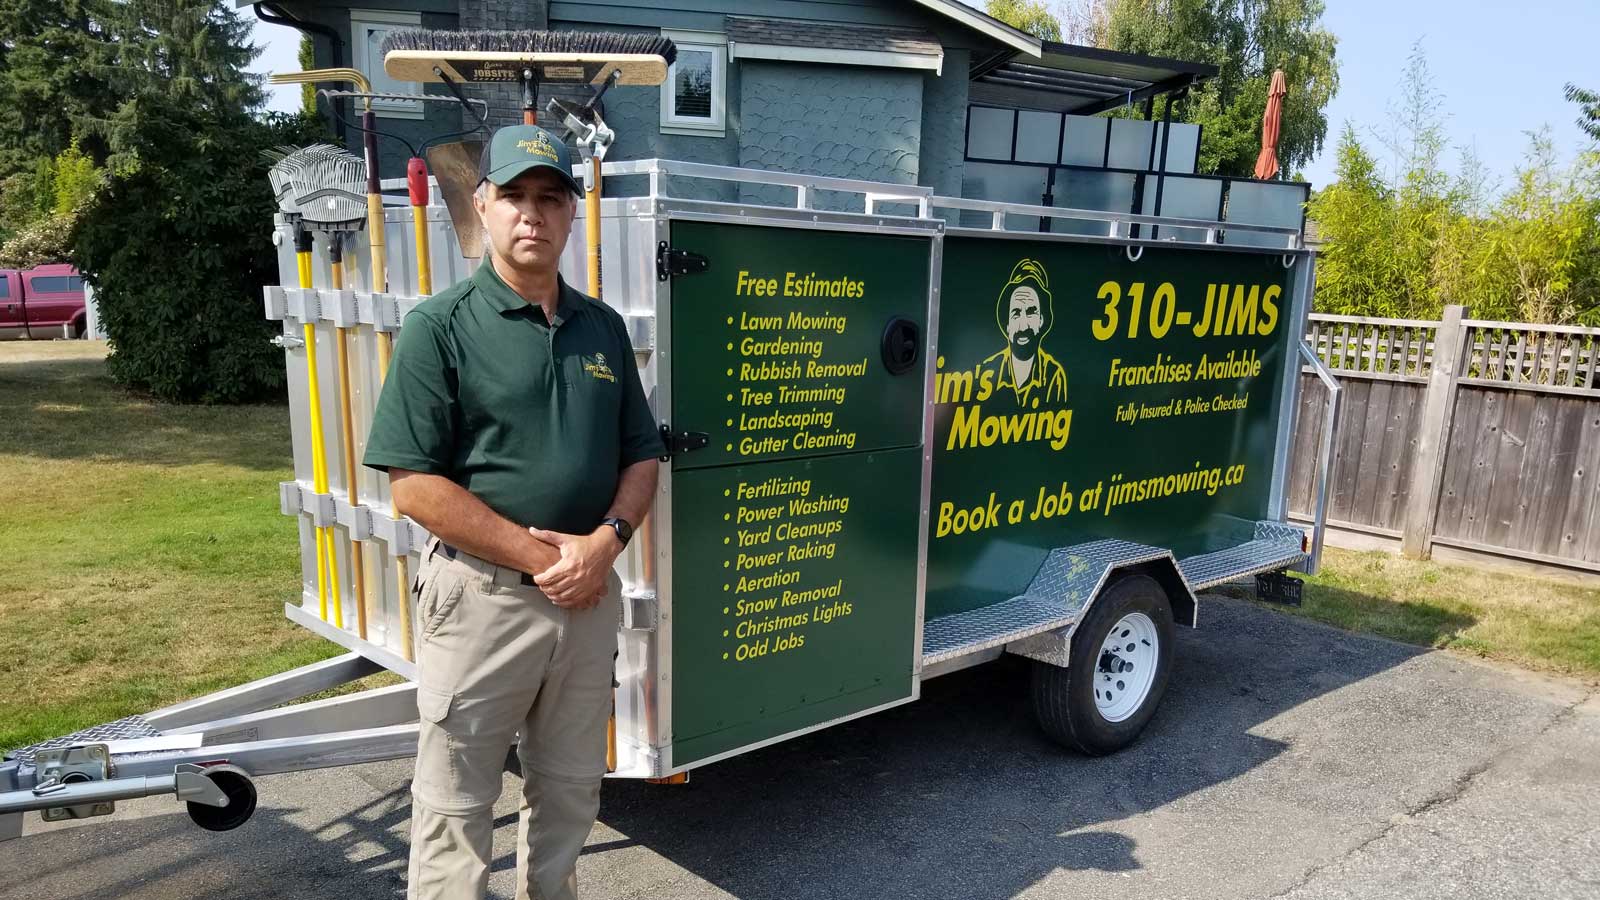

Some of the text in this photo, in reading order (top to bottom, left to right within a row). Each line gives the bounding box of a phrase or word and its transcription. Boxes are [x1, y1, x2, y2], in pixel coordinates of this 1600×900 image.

[473, 69, 515, 78] JOBSITE
[526, 147, 559, 162] Mowing
[736, 270, 865, 298] Free Estimates
[739, 311, 847, 334] Lawn Mowing
[1091, 280, 1282, 341] 310-JIMS
[740, 335, 823, 359] Gardening
[739, 359, 868, 382] Rubbish Removal
[934, 355, 996, 405] im's
[1108, 350, 1262, 387] Franchises Available
[740, 384, 846, 406] Tree Trimming
[1116, 392, 1248, 426] Fully Insured & Police Checked
[739, 408, 833, 431] Landscaping
[946, 396, 1073, 452] Mowing
[739, 429, 856, 456] Gutter Cleaning
[737, 477, 811, 500] Fertilizing
[935, 462, 1246, 538] Book a Job at jimsmowing.ca
[736, 495, 849, 524] Power Washing
[737, 519, 842, 547] Yard Cleanups
[735, 541, 836, 571] Power Raking
[735, 569, 800, 594] Aeration
[735, 579, 842, 617] Snow Removal
[735, 602, 853, 639] Christmas Lights
[735, 633, 805, 662] Odd Jobs
